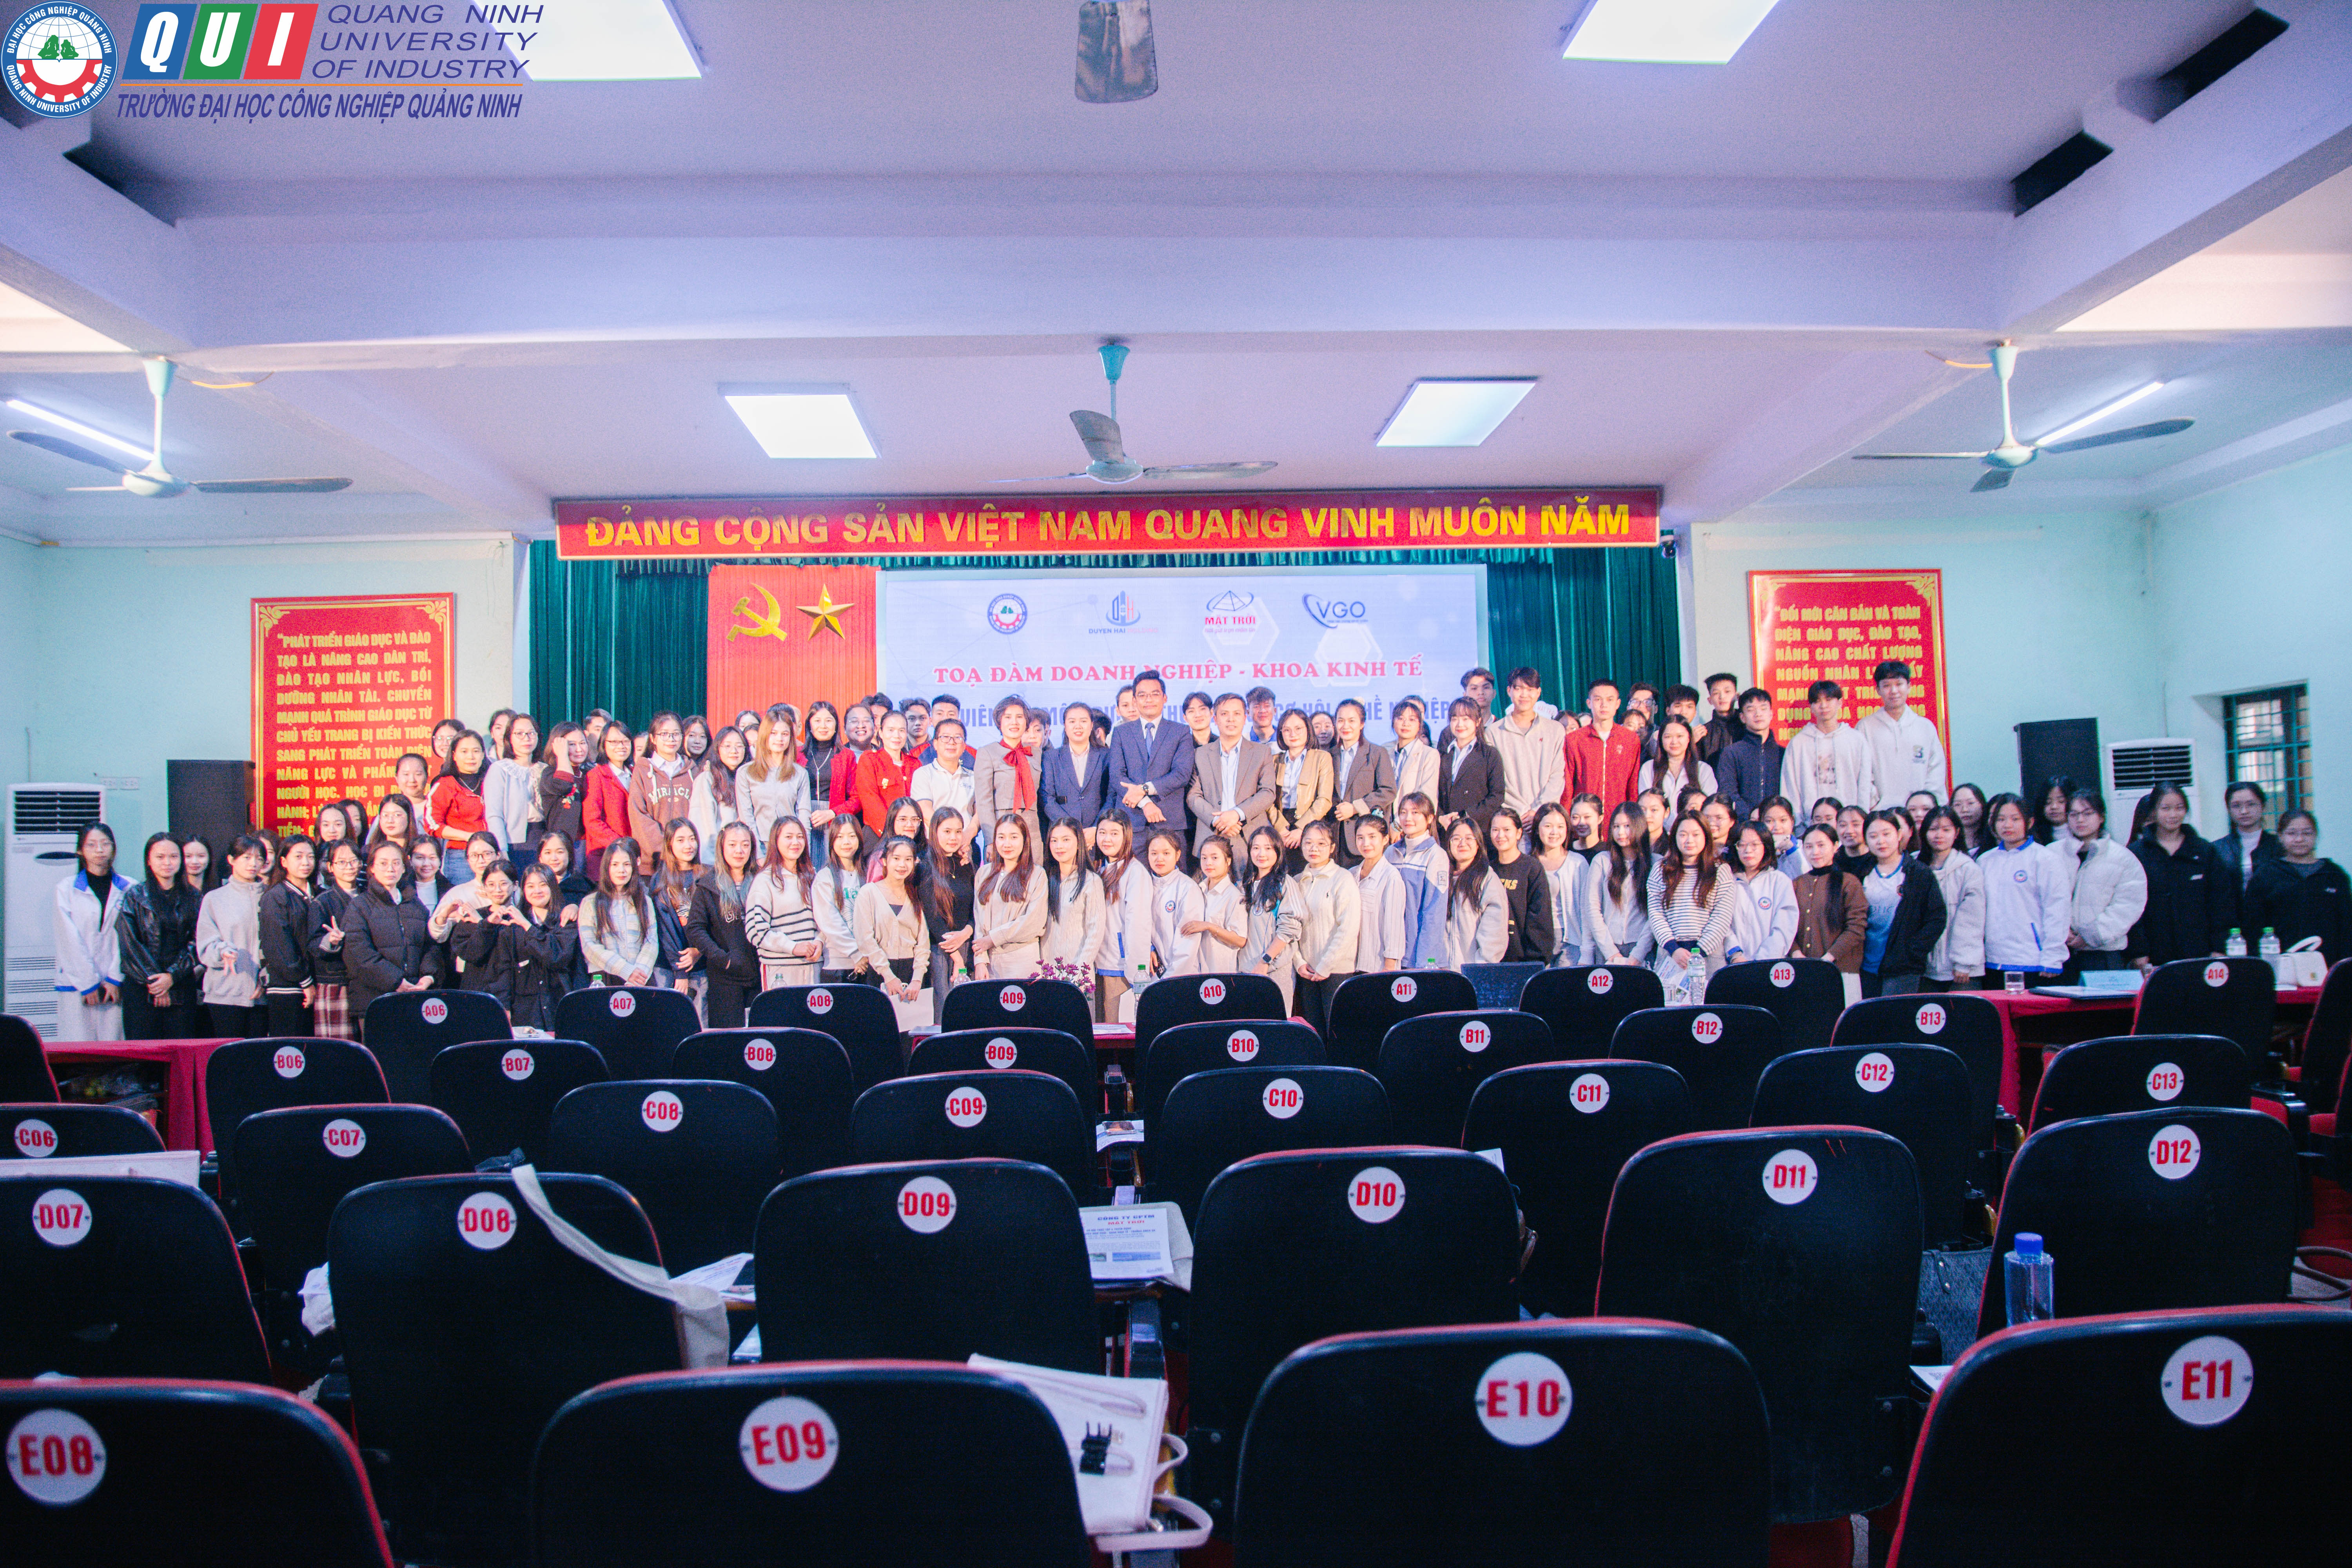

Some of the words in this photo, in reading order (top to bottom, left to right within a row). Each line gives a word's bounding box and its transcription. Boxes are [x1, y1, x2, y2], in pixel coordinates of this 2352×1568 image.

[585, 505, 700, 547] ĐẢNG
[714, 506, 828, 551] CỘNG
[842, 503, 925, 543] SẢN
[937, 503, 1024, 548] VIỆT
[1039, 510, 1131, 541] NAM
[1145, 508, 1288, 540] QUANG
[1301, 507, 1395, 538] VINH
[1409, 498, 1526, 537] MUÔN
[1539, 495, 1630, 536] NĂM
[1316, 601, 1365, 618] VGO
[312, 630, 343, 647] TRIỂN
[344, 632, 369, 646] GIÁO
[371, 634, 393, 648] DỤC
[394, 631, 408, 644] VÀ
[410, 630, 431, 644] ĐÀO
[277, 655, 297, 669] TẠO
[303, 652, 316, 666] LÀ
[321, 652, 352, 666] NÂNG
[357, 653, 378, 665] CAO
[384, 650, 406, 664] DÂN
[1815, 648, 1839, 660] CAO
[277, 671, 301, 686] ĐÀO
[308, 673, 330, 688] TẠO
[337, 670, 370, 684] NHÂN
[934, 668, 982, 687] TOẠ
[990, 662, 1043, 682] ĐÀM
[1051, 665, 1136, 681] DOANH
[1252, 662, 1320, 678] KHOA
[1327, 661, 1386, 677] KINH
[1394, 653, 1423, 676] TẾ
[321, 689, 353, 703] NHÂN
[387, 684, 432, 702] CHUYỂN
[1855, 686, 1881, 699] TRI
[277, 711, 309, 725] MẠNH
[310, 708, 332, 723] QUÁ
[334, 707, 365, 722] TRÌNH
[367, 707, 393, 721] GIÁO
[394, 708, 417, 722] DỤC
[418, 705, 433, 719] TỪ
[961, 704, 993, 727] VIÊ
[276, 727, 298, 743] CHỦ
[301, 726, 321, 742] YẾU
[324, 728, 359, 741] TRANG
[361, 728, 374, 743] BỊ
[376, 725, 402, 740] KIẾN
[404, 725, 432, 739] THỨC
[276, 748, 306, 762] SANG
[309, 746, 337, 761] PHÁT
[339, 743, 371, 760] TRIỂN
[374, 745, 403, 759] TOÀN
[276, 766, 309, 780] NĂNG
[314, 766, 336, 782] LỰC
[342, 765, 357, 779] VÀ
[277, 785, 310, 800] NGƯỜI
[346, 786, 368, 800] HỌC
[374, 786, 385, 797] ĐI
[648, 787, 690, 805] MIRACL
[1592, 975, 1609, 987] A12
[1774, 969, 1790, 980] A13
[1002, 992, 1023, 1004] A09
[1203, 985, 1222, 998] A10
[1396, 984, 1411, 995] A11
[613, 998, 632, 1009] A07
[810, 995, 831, 1007] A08
[425, 1005, 445, 1016] A06
[1920, 1011, 1941, 1025] B13
[1466, 1029, 1485, 1043] B11
[1697, 1020, 1717, 1035] B12
[748, 1046, 773, 1062] B08
[988, 1045, 1014, 1060] B09
[1232, 1038, 1254, 1053] B10
[277, 1054, 302, 1069] B06
[505, 1057, 530, 1071] B07
[1862, 1063, 1887, 1082] C12
[2152, 1073, 2177, 1090] C13
[1269, 1088, 1298, 1107] C10
[1577, 1084, 1601, 1102] C11
[646, 1101, 679, 1120] C08
[949, 1097, 983, 1116] C09
[20, 1129, 54, 1147] C06
[328, 1129, 360, 1146] C07
[2157, 1139, 2191, 1165] D12
[1773, 1164, 1806, 1189] D11
[1356, 1181, 1396, 1207] D10
[904, 1191, 950, 1217] D09
[39, 1204, 83, 1229] D07
[464, 1208, 510, 1233] D08
[2182, 1360, 2232, 1400] E11
[1487, 1380, 1560, 1417] E10
[752, 1421, 826, 1465] E09
[20, 1436, 93, 1475] E08
